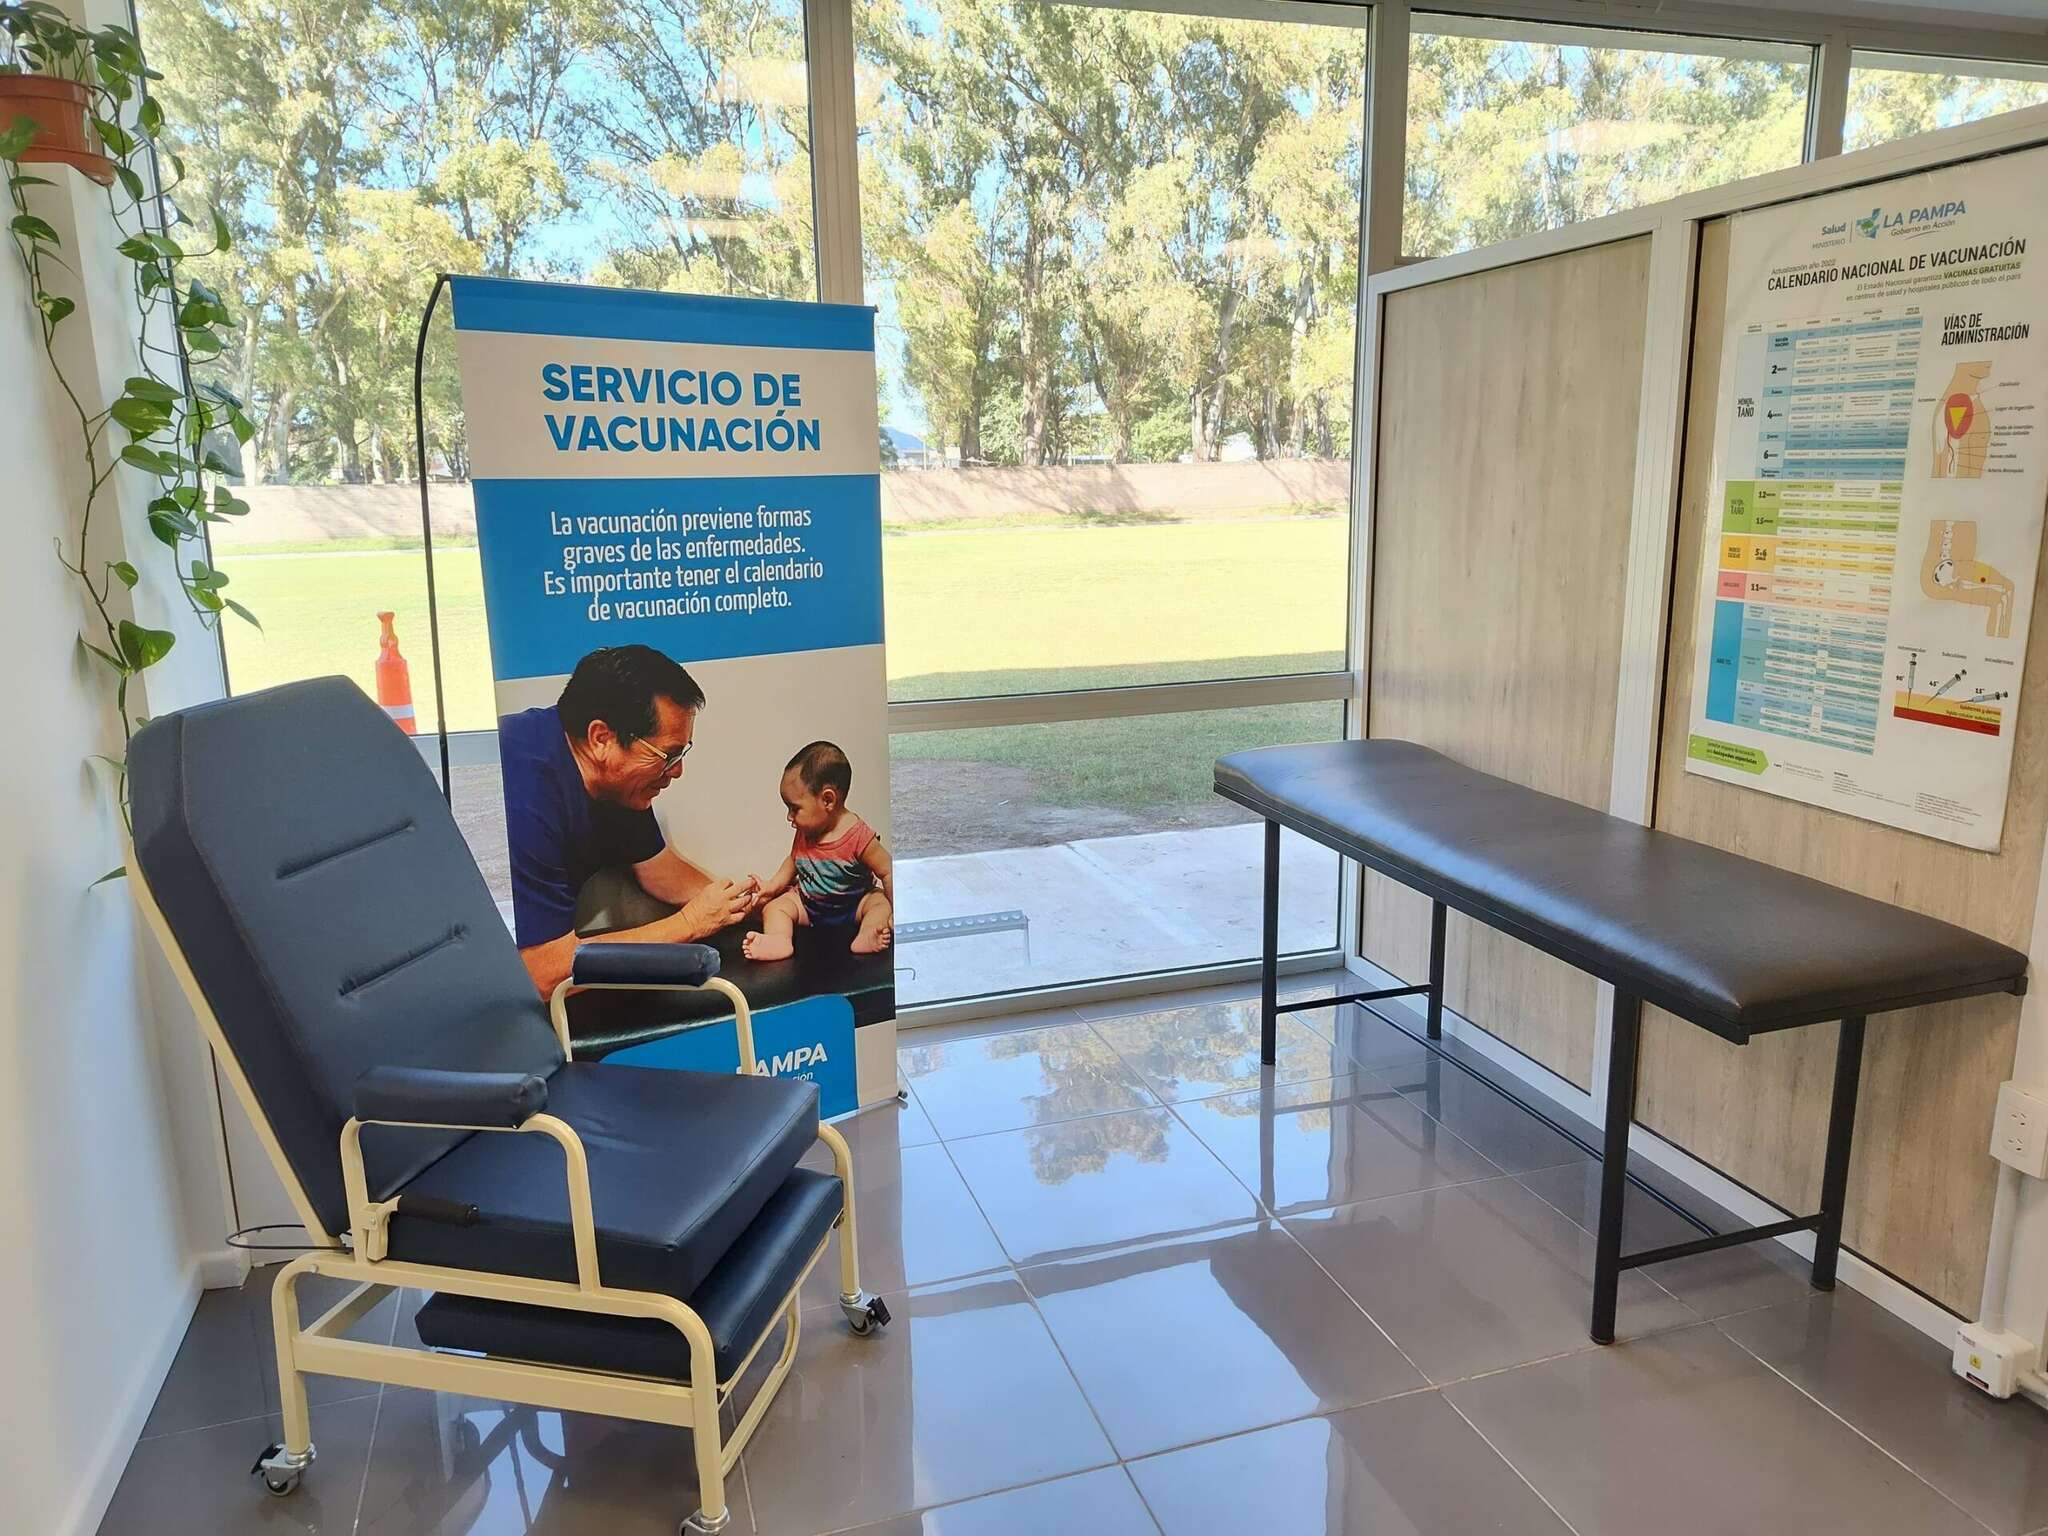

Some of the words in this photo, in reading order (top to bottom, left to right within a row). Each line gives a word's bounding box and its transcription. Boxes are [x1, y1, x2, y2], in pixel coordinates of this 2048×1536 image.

[1821, 222, 1846, 235] Salud
[1883, 212, 1904, 229] LA
[1909, 200, 1967, 225] PAMPA
[1768, 268, 1839, 291] CALENDARIO
[1841, 258, 1905, 281] NACIONAL
[1909, 254, 1926, 270] DE
[1930, 237, 2026, 267] VACUNACIÓN
[1943, 268, 1978, 280] VACUNAS
[1979, 261, 2022, 275] GRATUITAS
[1941, 321, 2030, 346] ADMINISTRACIÓN
[1944, 313, 1967, 331] VÍAS
[1969, 313, 1983, 328] DE
[541, 362, 743, 407] SERVICIO
[753, 372, 801, 407] DE
[1771, 365, 1778, 375] 2
[545, 410, 821, 452] VACUNACIÓN
[551, 511, 572, 536] La
[577, 508, 678, 535] vacunación
[682, 508, 753, 537] previene
[756, 505, 812, 530] formas
[563, 545, 626, 570] graves
[630, 537, 652, 562] de
[657, 536, 681, 561] las
[685, 532, 806, 560] enfermedades.
[544, 571, 566, 595] Es
[570, 565, 672, 599] importante
[676, 565, 721, 588] tener
[726, 560, 740, 584] el
[744, 557, 824, 583] calendario
[588, 597, 611, 622] de
[615, 592, 711, 620] vacunación
[714, 587, 792, 615] completo.
[735, 1043, 828, 1077] AMPA
